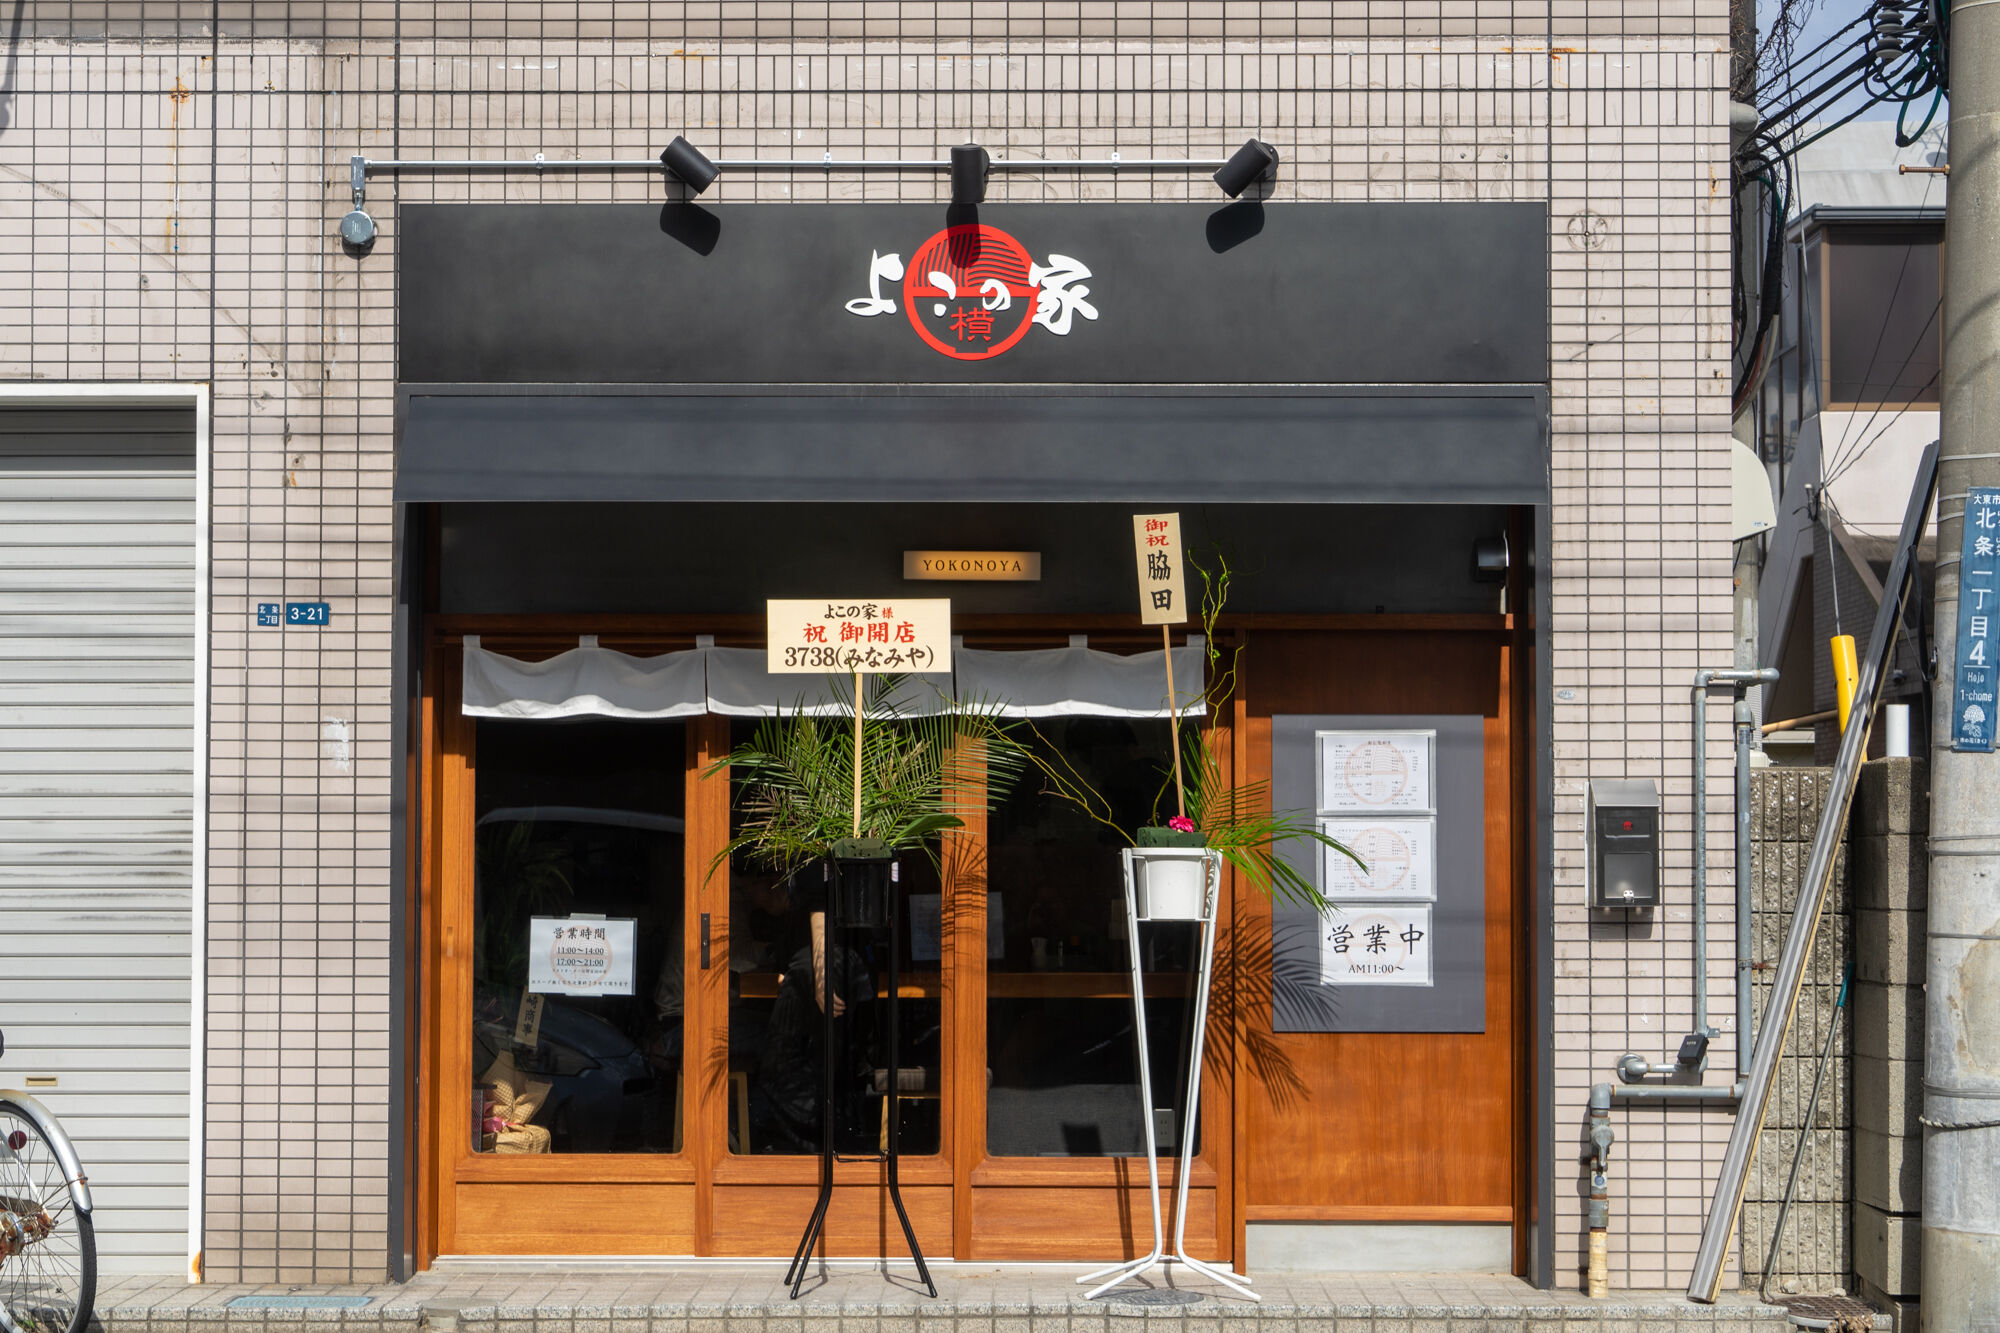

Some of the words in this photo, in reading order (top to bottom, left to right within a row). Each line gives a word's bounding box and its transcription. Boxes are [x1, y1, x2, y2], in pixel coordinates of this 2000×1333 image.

[950, 306, 995, 341] 横
[1144, 519, 1169, 547] 御祝
[923, 559, 1022, 572] YOKONOYA
[1147, 549, 1172, 611] 脇田
[259, 615, 278, 624] 一丁目
[291, 607, 323, 620] 3-21
[1960, 688, 1993, 702] 1-chome
[553, 926, 606, 940] 営業時間
[1327, 923, 1424, 955] 営業中
